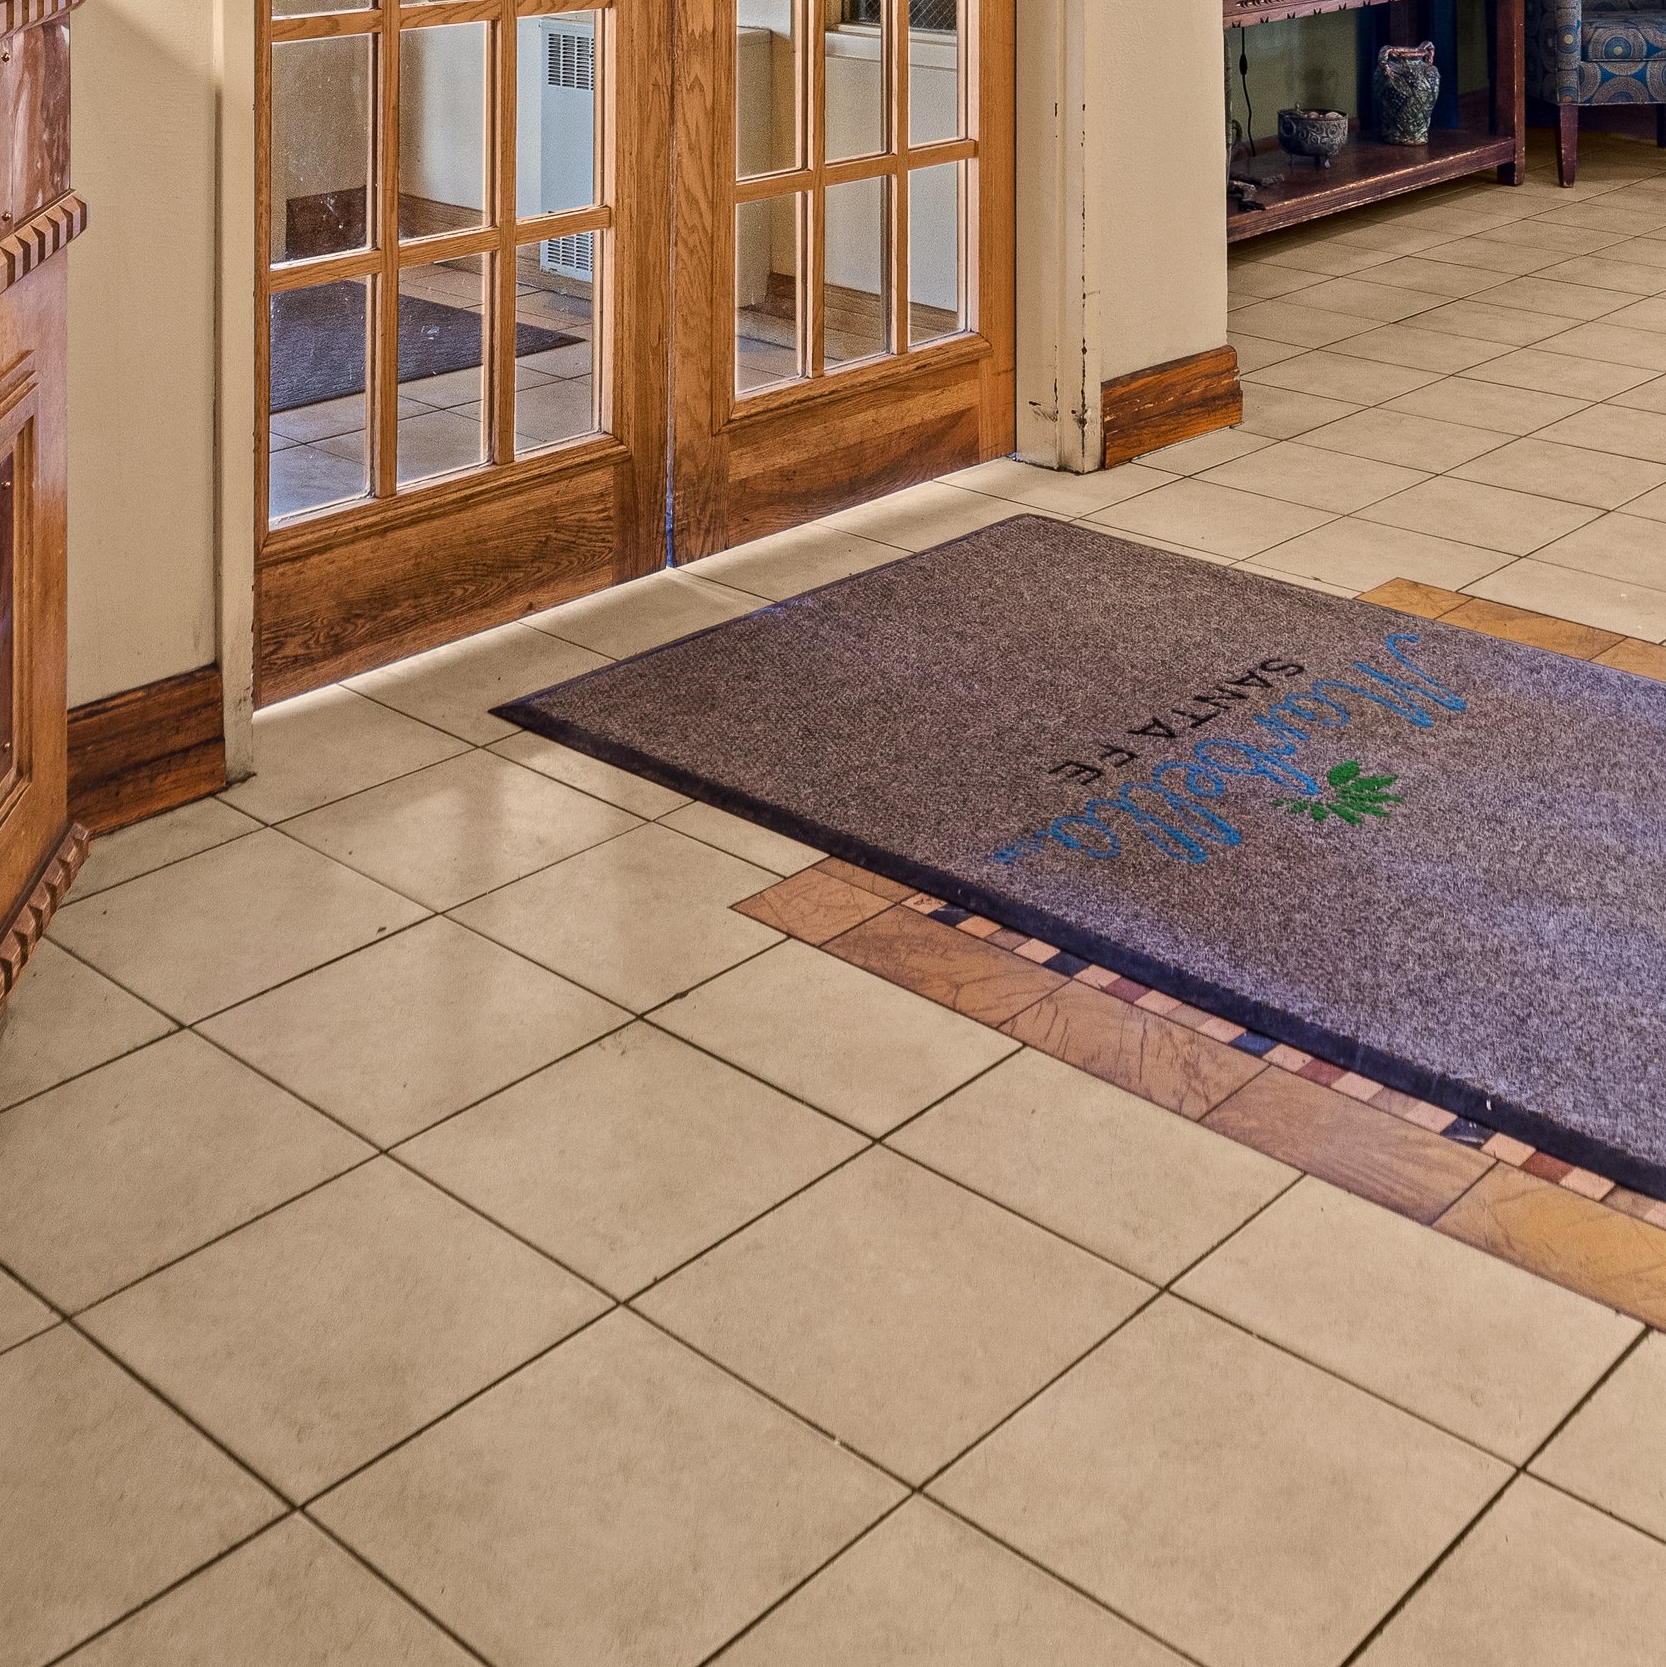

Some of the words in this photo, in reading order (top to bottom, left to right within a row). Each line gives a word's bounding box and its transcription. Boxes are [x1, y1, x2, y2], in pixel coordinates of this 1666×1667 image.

[1127, 657, 1305, 741] SANTA
[1031, 634, 1468, 865] Marbella
[1047, 742, 1139, 786] FE
